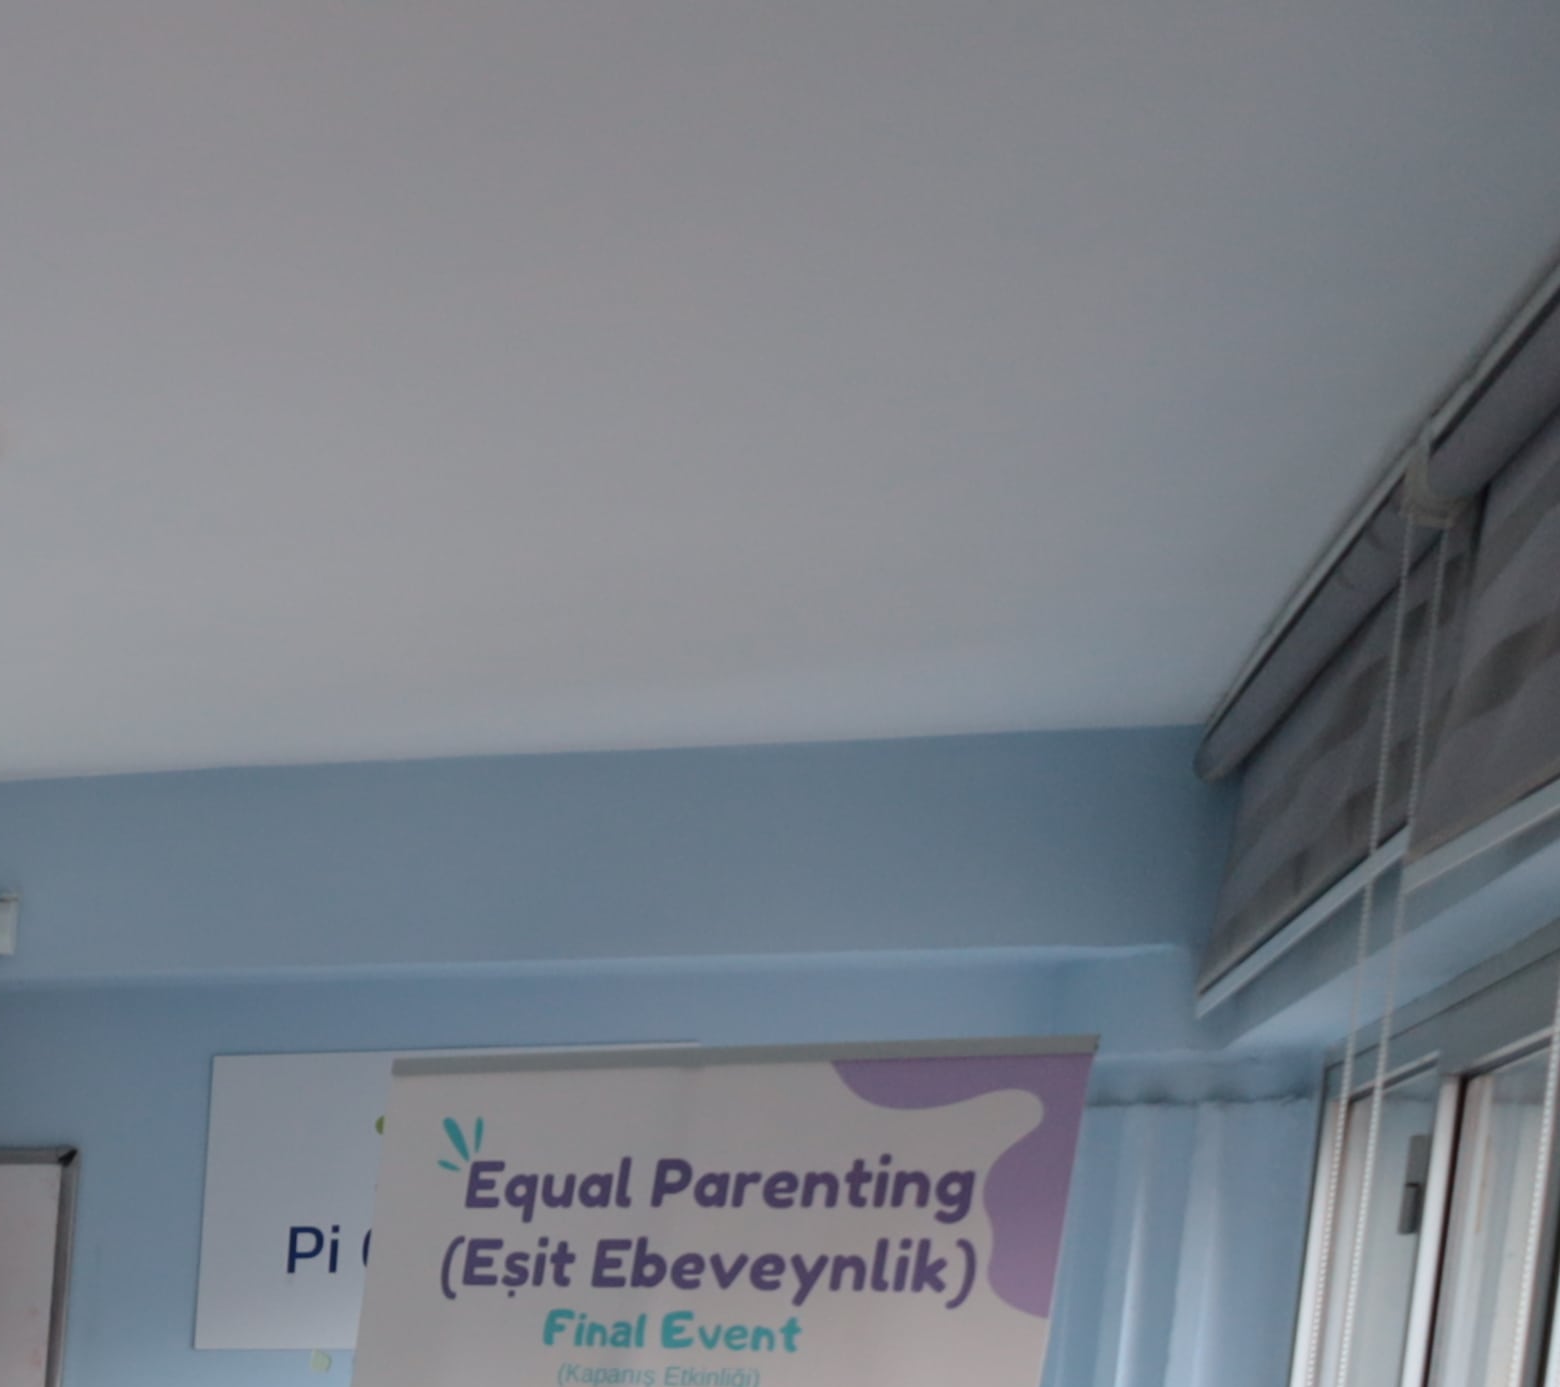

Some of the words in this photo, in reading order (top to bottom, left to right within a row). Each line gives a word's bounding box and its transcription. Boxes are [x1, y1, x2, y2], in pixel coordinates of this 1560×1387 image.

[465, 1157, 632, 1223] Equal
[651, 1154, 976, 1224] Parenting
[285, 1225, 340, 1273] Pi
[440, 1236, 576, 1299] (Eşit
[590, 1237, 977, 1309] Ebeveynlik)
[542, 1308, 645, 1348] Final
[661, 1310, 803, 1352] Event
